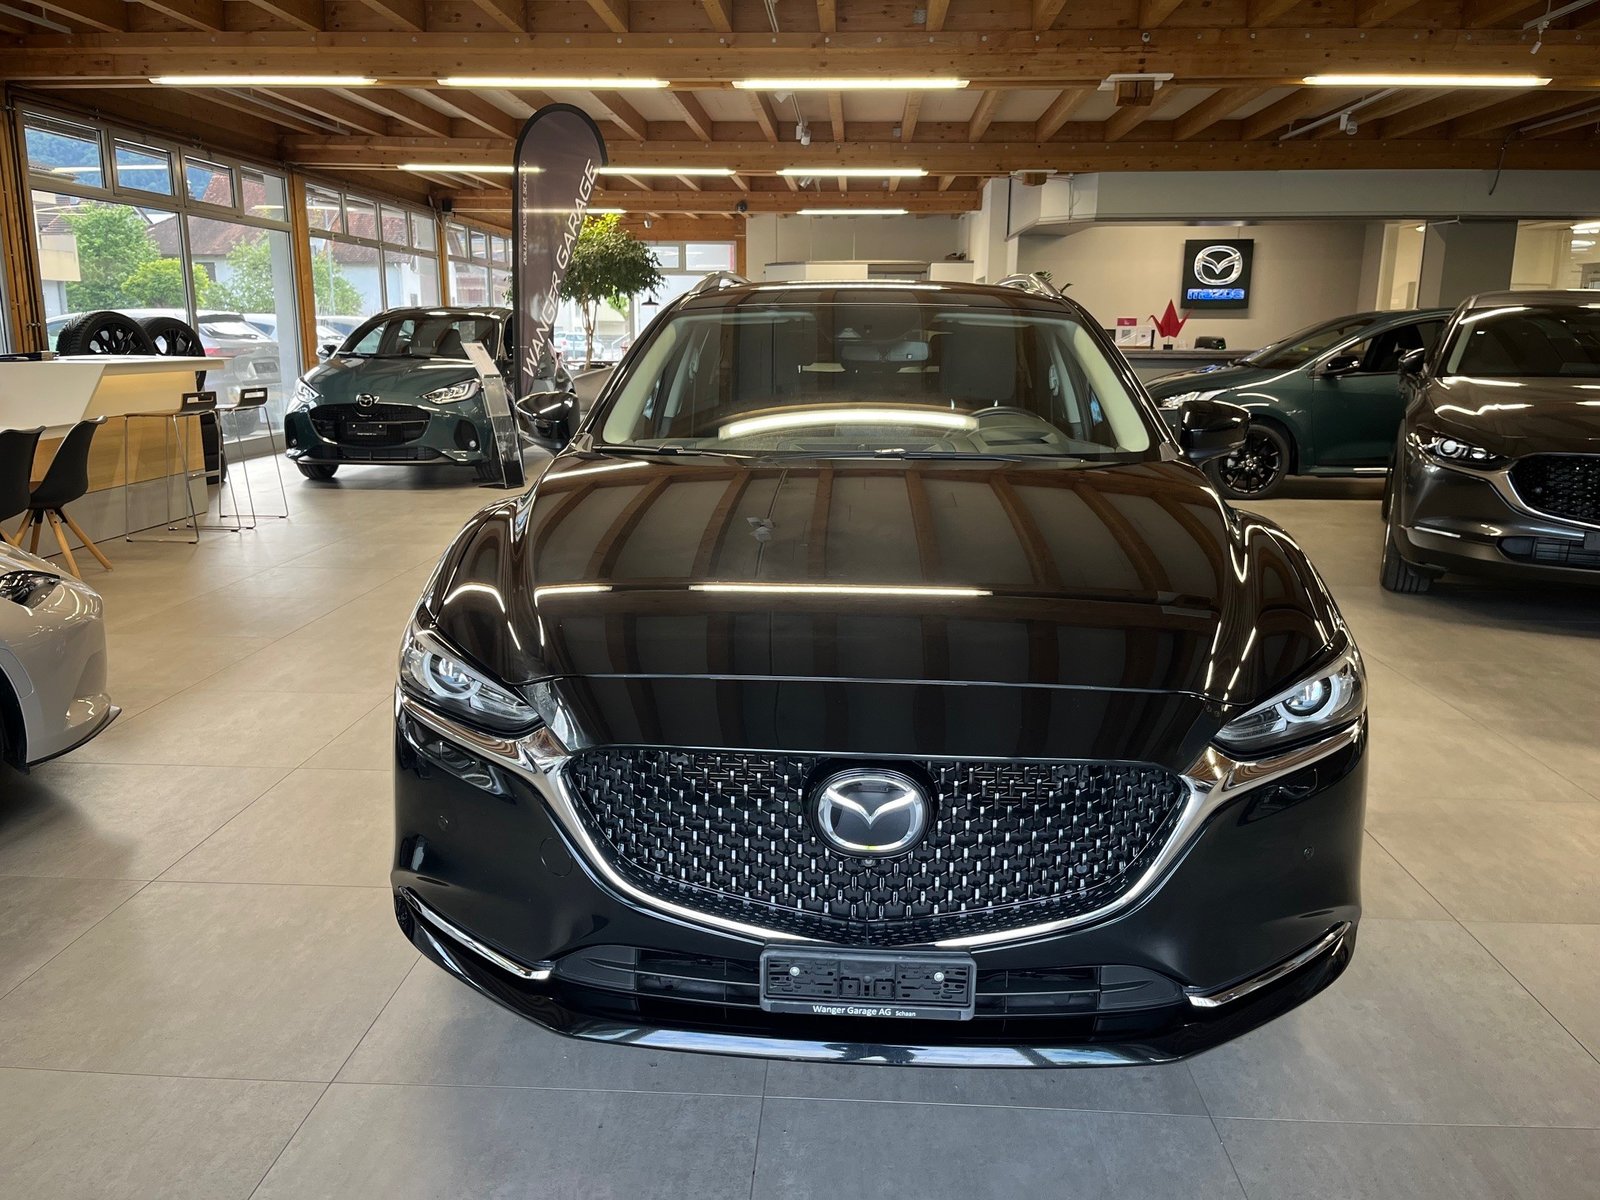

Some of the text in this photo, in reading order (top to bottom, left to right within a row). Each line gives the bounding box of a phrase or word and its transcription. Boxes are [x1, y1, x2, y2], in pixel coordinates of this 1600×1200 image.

[522, 158, 597, 378] WANGER GARAGE
[812, 1005, 845, 1015] Wanger
[847, 1006, 877, 1016] Garage
[878, 1008, 892, 1016] AG
